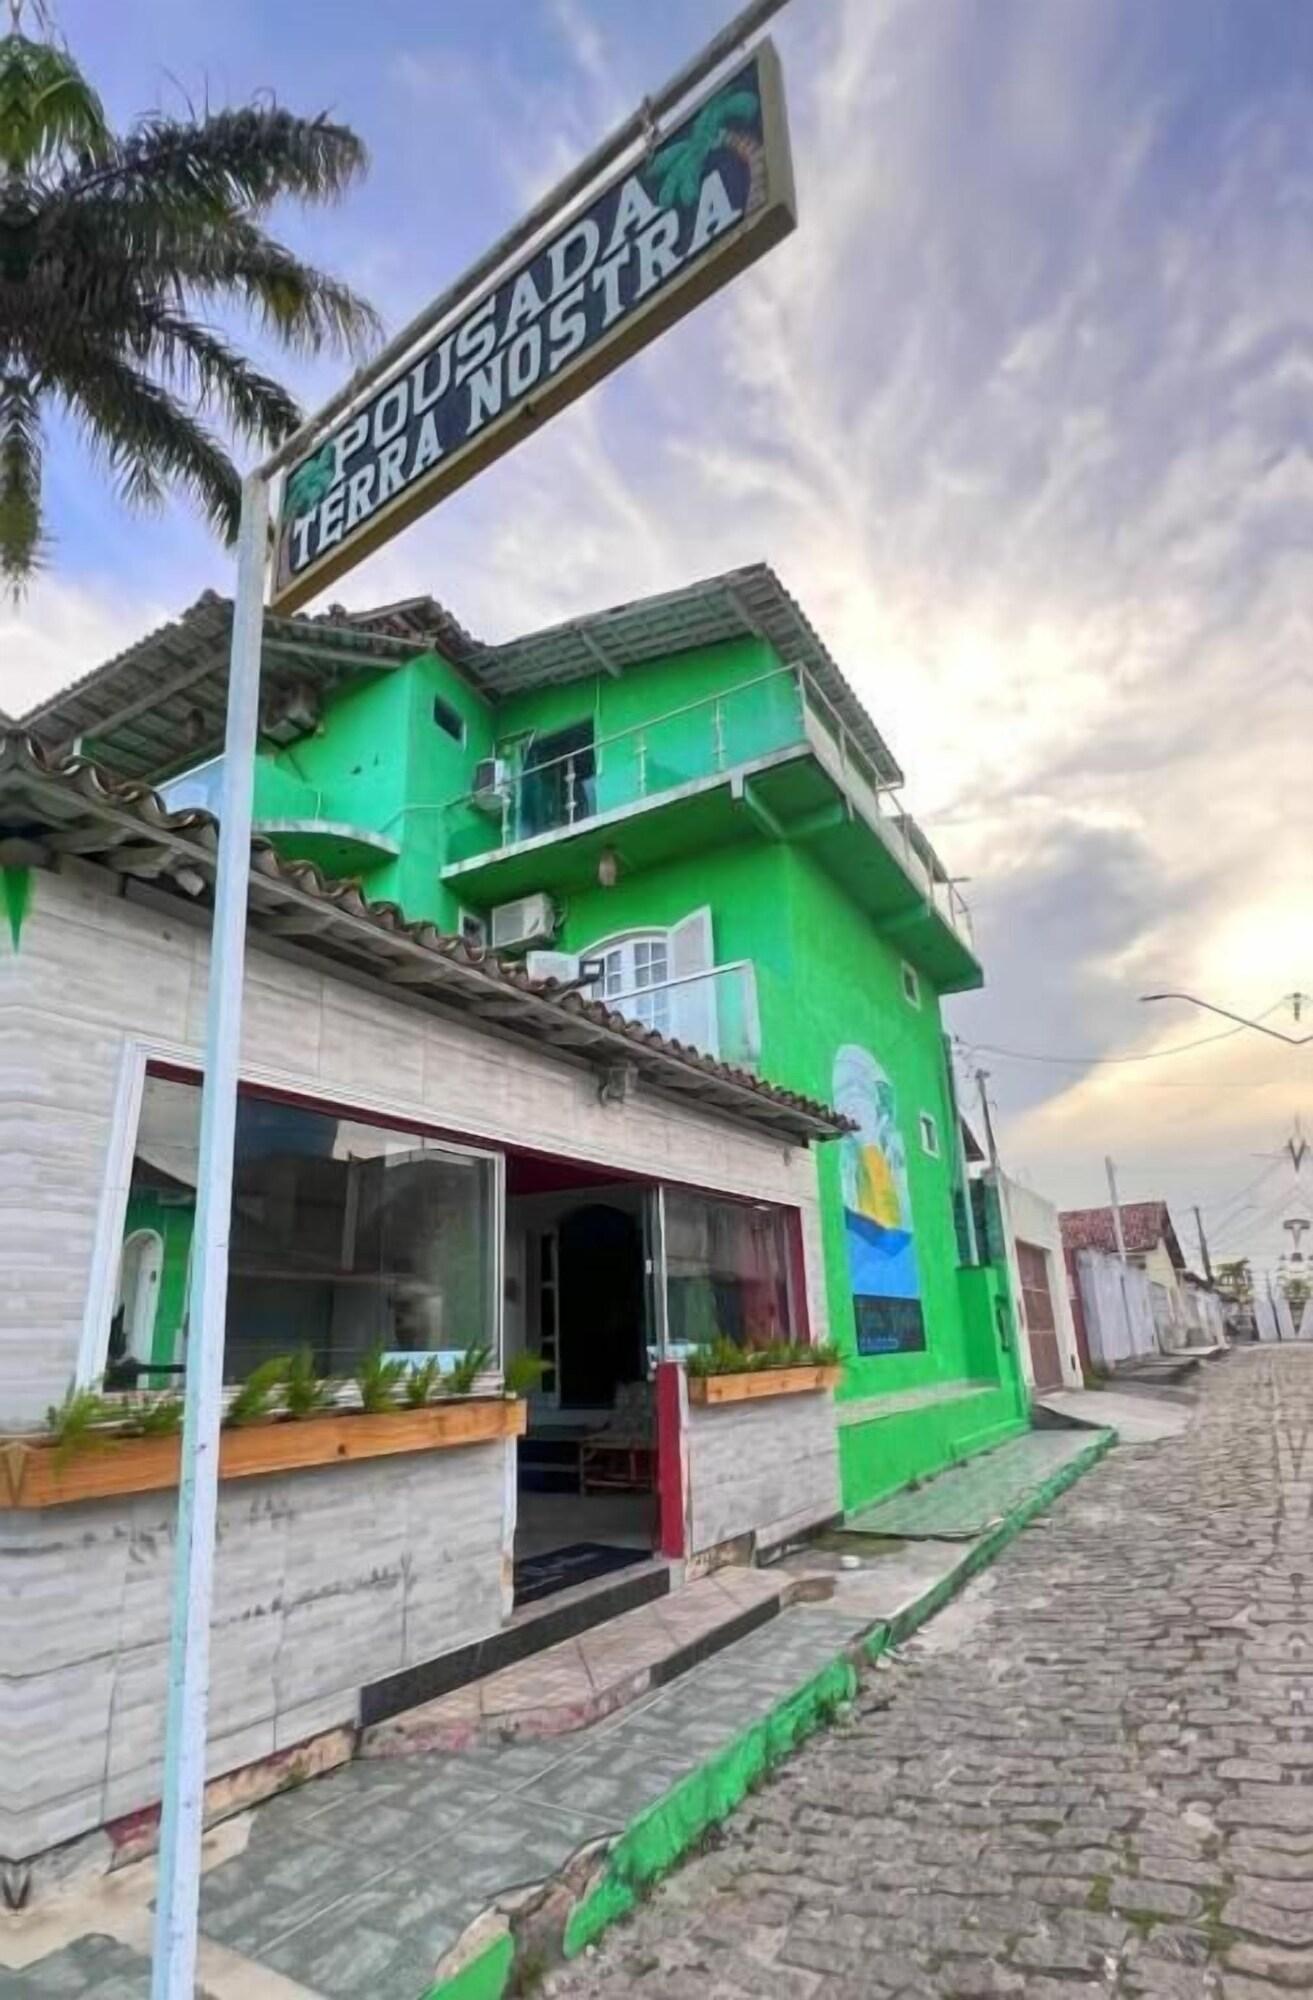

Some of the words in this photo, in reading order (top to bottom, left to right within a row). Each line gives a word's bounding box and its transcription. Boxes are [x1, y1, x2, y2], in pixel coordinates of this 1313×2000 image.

[292, 420, 443, 571] TERRA
[465, 171, 743, 436] NOSTRA
[332, 176, 661, 484] POUSADA
